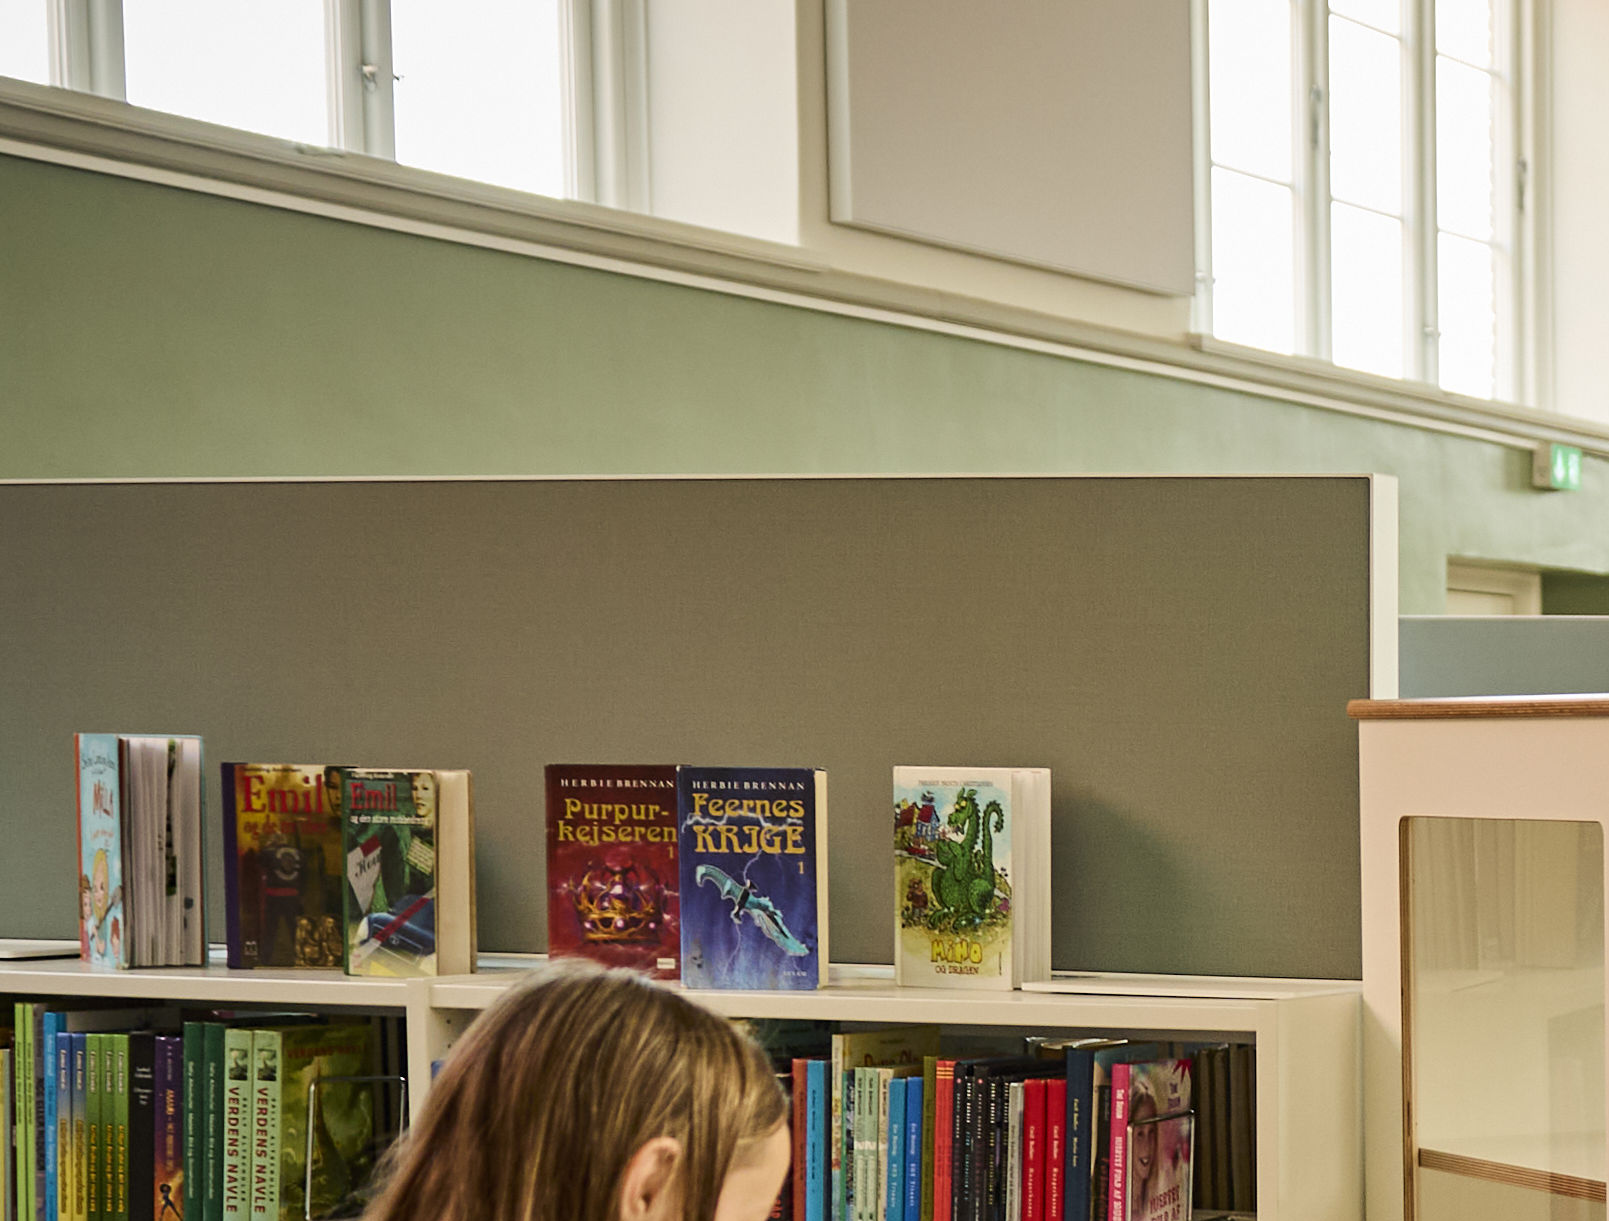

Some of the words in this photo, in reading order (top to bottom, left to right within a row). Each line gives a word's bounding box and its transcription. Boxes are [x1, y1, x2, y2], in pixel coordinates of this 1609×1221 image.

[241, 774, 324, 814] Emil
[351, 782, 398, 811] Emil
[561, 779, 613, 789] HERBIE
[616, 780, 674, 789] BRENNAN
[692, 781, 740, 790] HERBIE
[744, 782, 805, 791] BRENNAN
[564, 798, 670, 823] Purpur-
[692, 793, 806, 817] Feernes
[558, 821, 678, 846] kejseren
[693, 825, 806, 854] KRIGE
[668, 847, 675, 859] 1
[797, 862, 805, 874] 1
[228, 1087, 240, 1157] VERDENS
[256, 1088, 268, 1158] VERDENS
[226, 1164, 238, 1213] NAVLE
[254, 1164, 266, 1213] NAVLE
